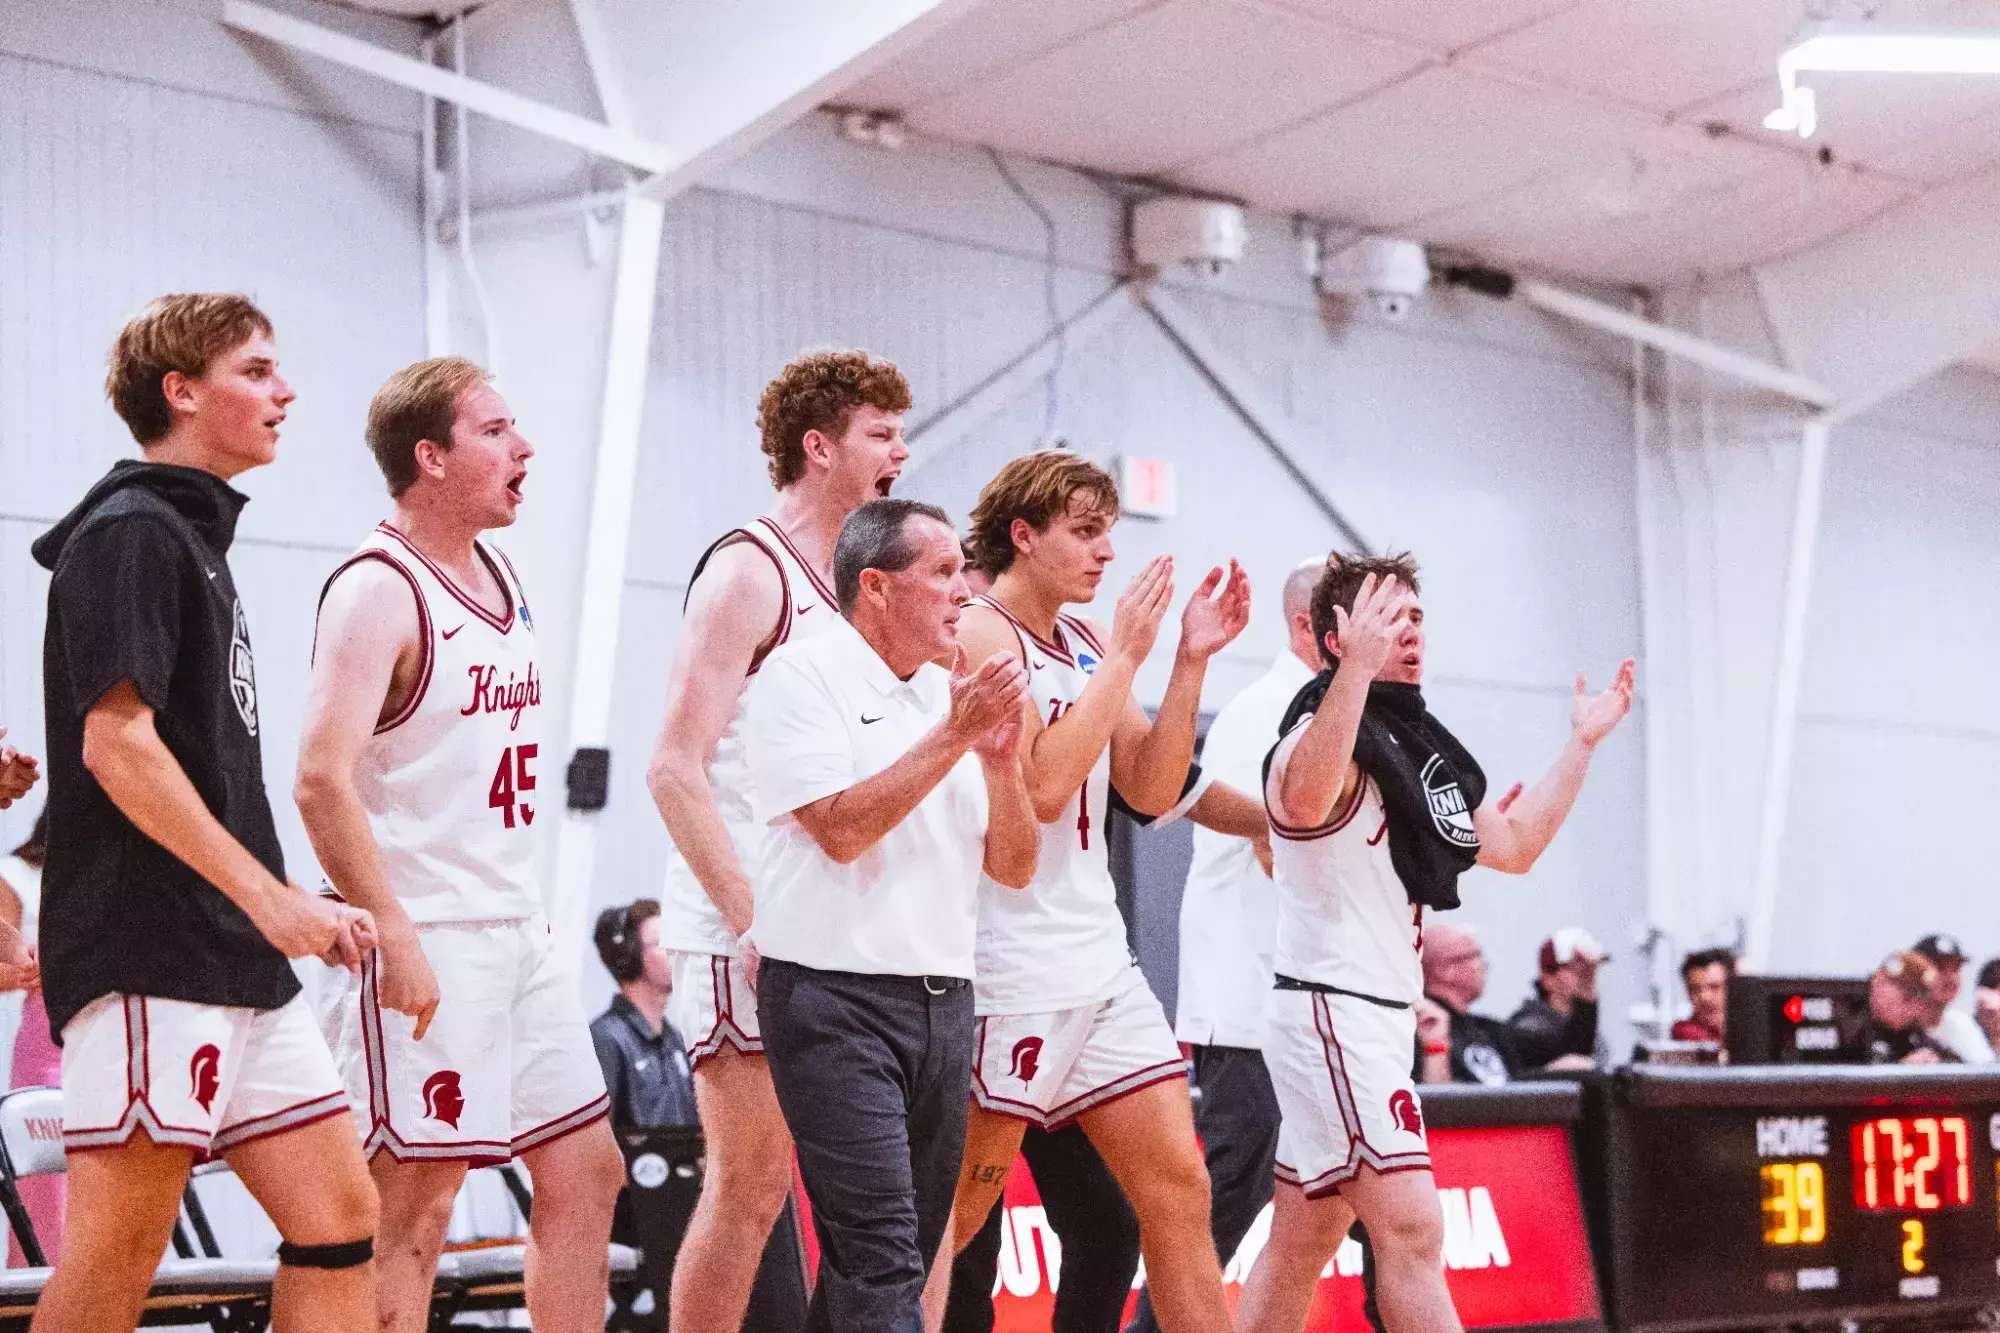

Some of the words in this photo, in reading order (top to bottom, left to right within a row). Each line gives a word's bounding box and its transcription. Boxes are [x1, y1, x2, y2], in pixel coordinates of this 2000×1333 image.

[489, 743, 538, 829] 45
[1756, 1116, 1829, 1156] HOME
[1862, 1117, 1971, 1209] 17:27
[1761, 1162, 1826, 1244] 39
[1902, 1219, 1925, 1273] 2
